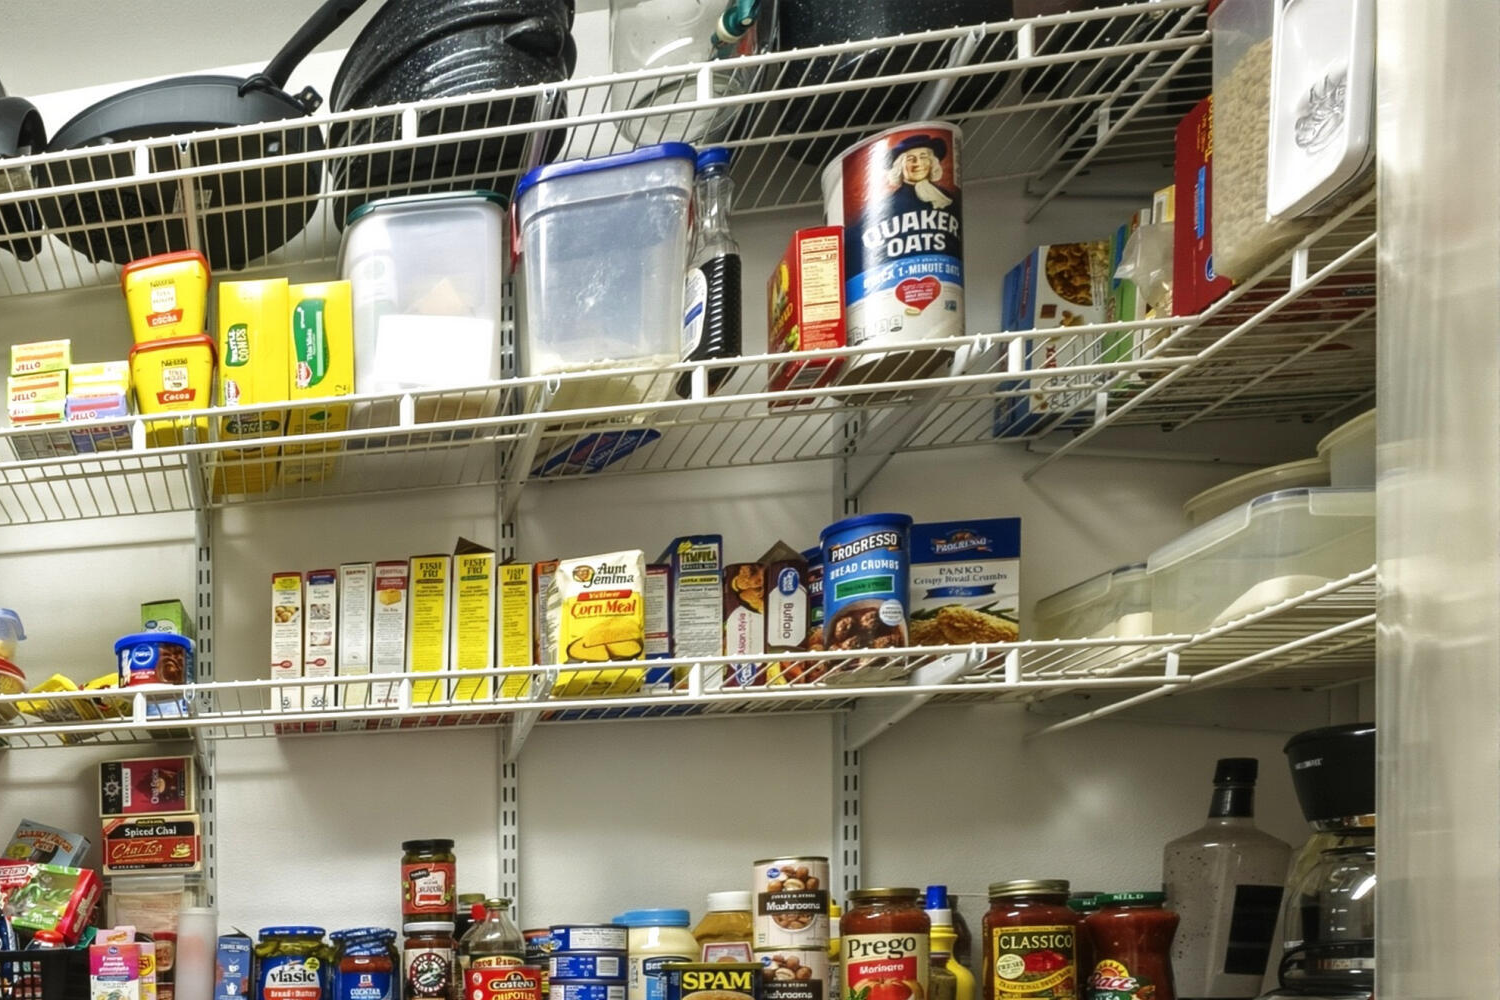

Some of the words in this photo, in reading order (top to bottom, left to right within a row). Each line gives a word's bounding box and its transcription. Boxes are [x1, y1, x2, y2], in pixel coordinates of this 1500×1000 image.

[861, 209, 960, 249] QUAKER
[886, 233, 947, 258] OATS
[830, 532, 898, 563] PROGRESSO
[463, 558, 487, 568] FISH
[596, 562, 628, 575] Aunt
[938, 565, 984, 575] PANKO
[583, 571, 635, 588] Jemima
[829, 564, 859, 580] BREAD
[913, 575, 944, 586] Crispy
[570, 600, 603, 618] Corn
[605, 599, 637, 614] Meal
[783, 602, 794, 639] Buffalo
[124, 827, 154, 838] Spiced
[1113, 893, 1144, 901] MILD
[766, 901, 821, 911] Mushrooms
[846, 935, 917, 961] Prego
[999, 934, 1073, 950] CLASSICO
[269, 966, 316, 985] vlasic
[859, 963, 905, 975] Marinara
[682, 971, 752, 990] SPAM
